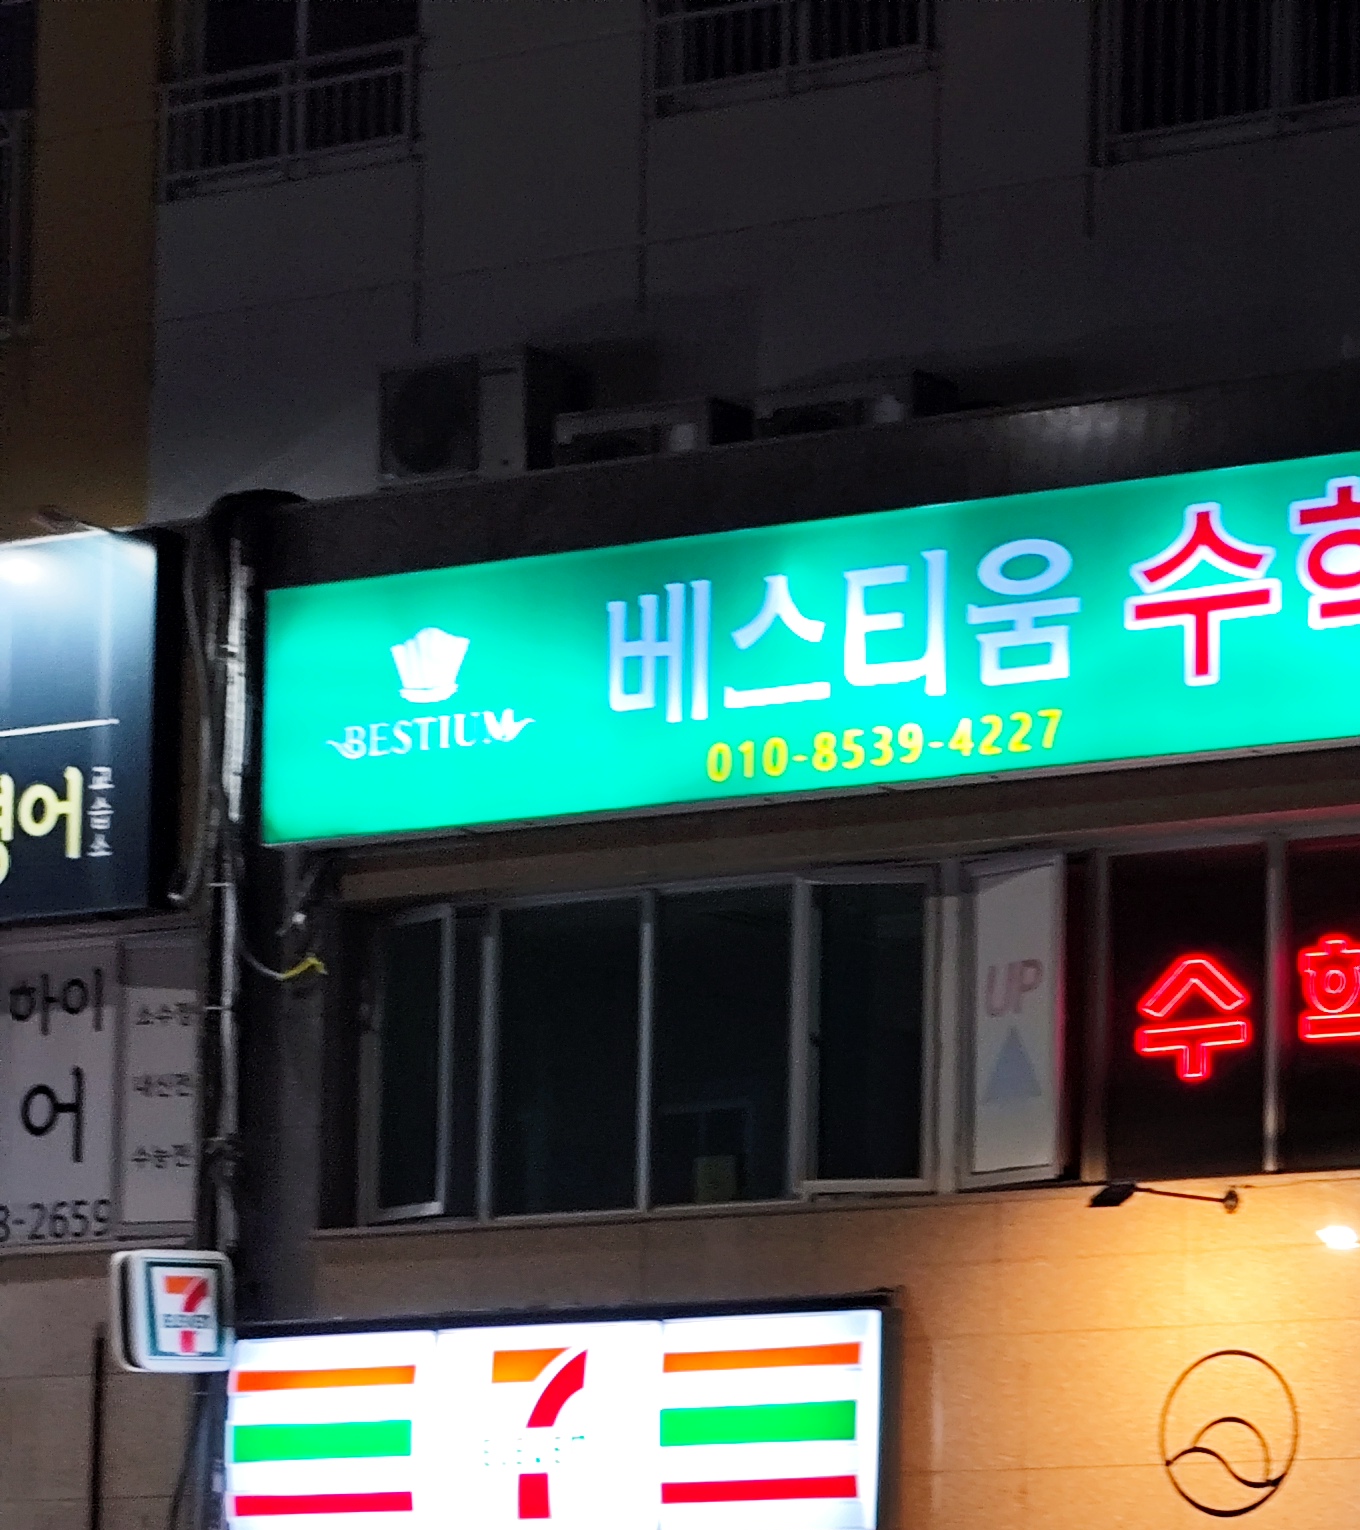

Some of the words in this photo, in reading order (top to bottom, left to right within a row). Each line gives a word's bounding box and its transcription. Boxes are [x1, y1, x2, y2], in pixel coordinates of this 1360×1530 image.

[606, 536, 1083, 725] 베스티움
[705, 709, 1064, 784] 010-8539-4227
[87, 766, 115, 857] 교습소
[985, 958, 1043, 1019] UP
